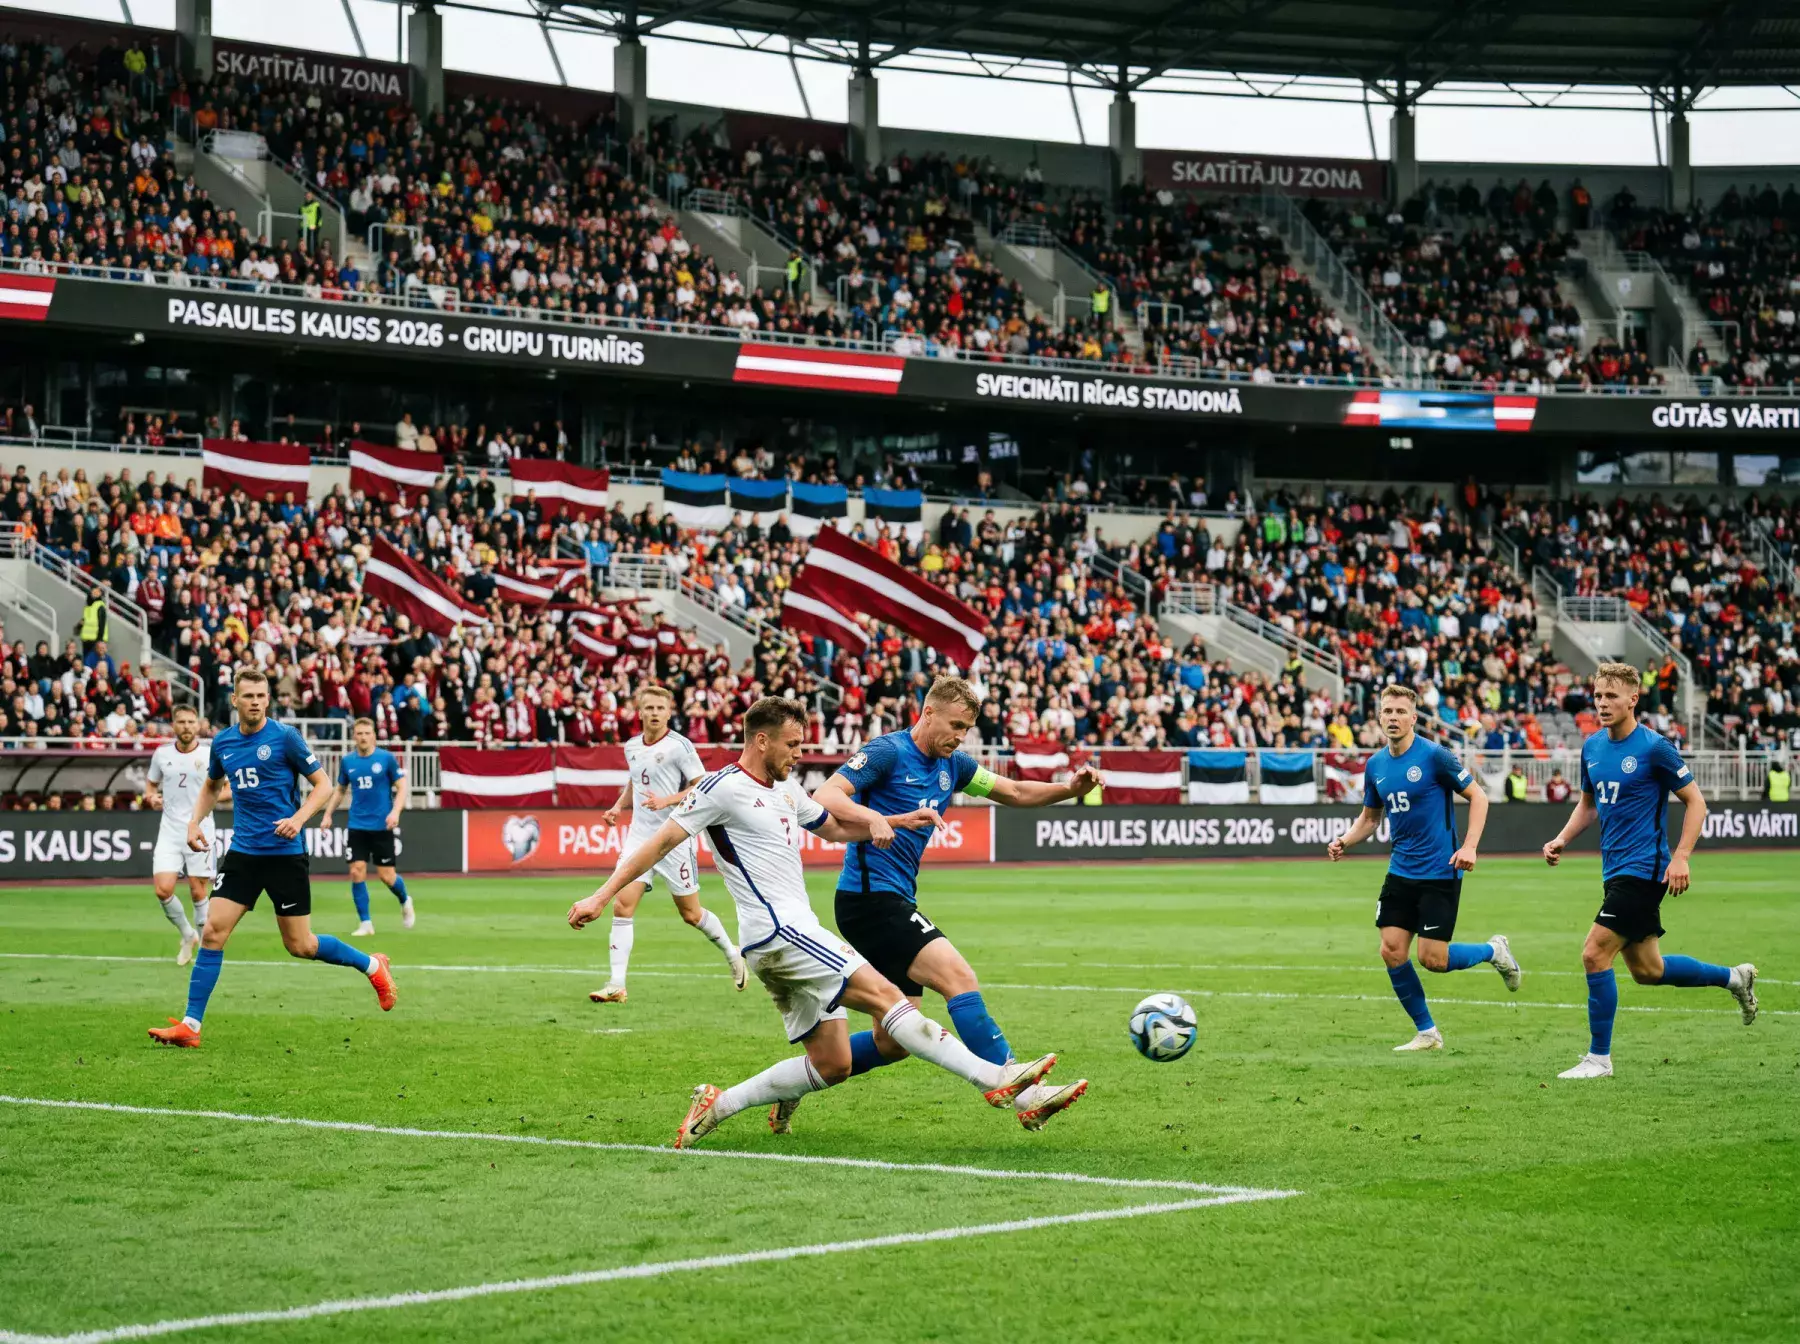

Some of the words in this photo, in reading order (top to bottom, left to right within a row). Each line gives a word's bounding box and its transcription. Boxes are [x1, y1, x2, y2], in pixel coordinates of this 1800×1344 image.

[340, 68, 401, 96] ZONA
[1172, 160, 1293, 186] SKATĪTĀJU
[1299, 167, 1363, 189] ZONA
[168, 298, 296, 334] PASAULES
[301, 311, 381, 342] KAUSS
[386, 318, 444, 347] 2026
[463, 326, 543, 357] GRUPU
[547, 334, 645, 366] TURNĪRS
[976, 373, 1079, 403] SVEICINĀTI
[1082, 379, 1140, 408] RĪGAS
[1142, 387, 1243, 414] STADIONĀ
[1652, 402, 1728, 428] GŪTĀS
[1731, 403, 1799, 428] VĀRTI
[178, 773, 187, 788] 2
[235, 767, 260, 790] 15
[641, 768, 650, 785] 6
[1387, 791, 1410, 813] 15
[1596, 780, 1620, 804] 17
[1036, 820, 1147, 847] PASAULES
[1151, 818, 1220, 845] KAUSS
[1224, 818, 1275, 844] 2026
[1748, 809, 1798, 837] VĀRTI
[24, 829, 131, 862] KAUSS
[680, 862, 690, 880] 6
